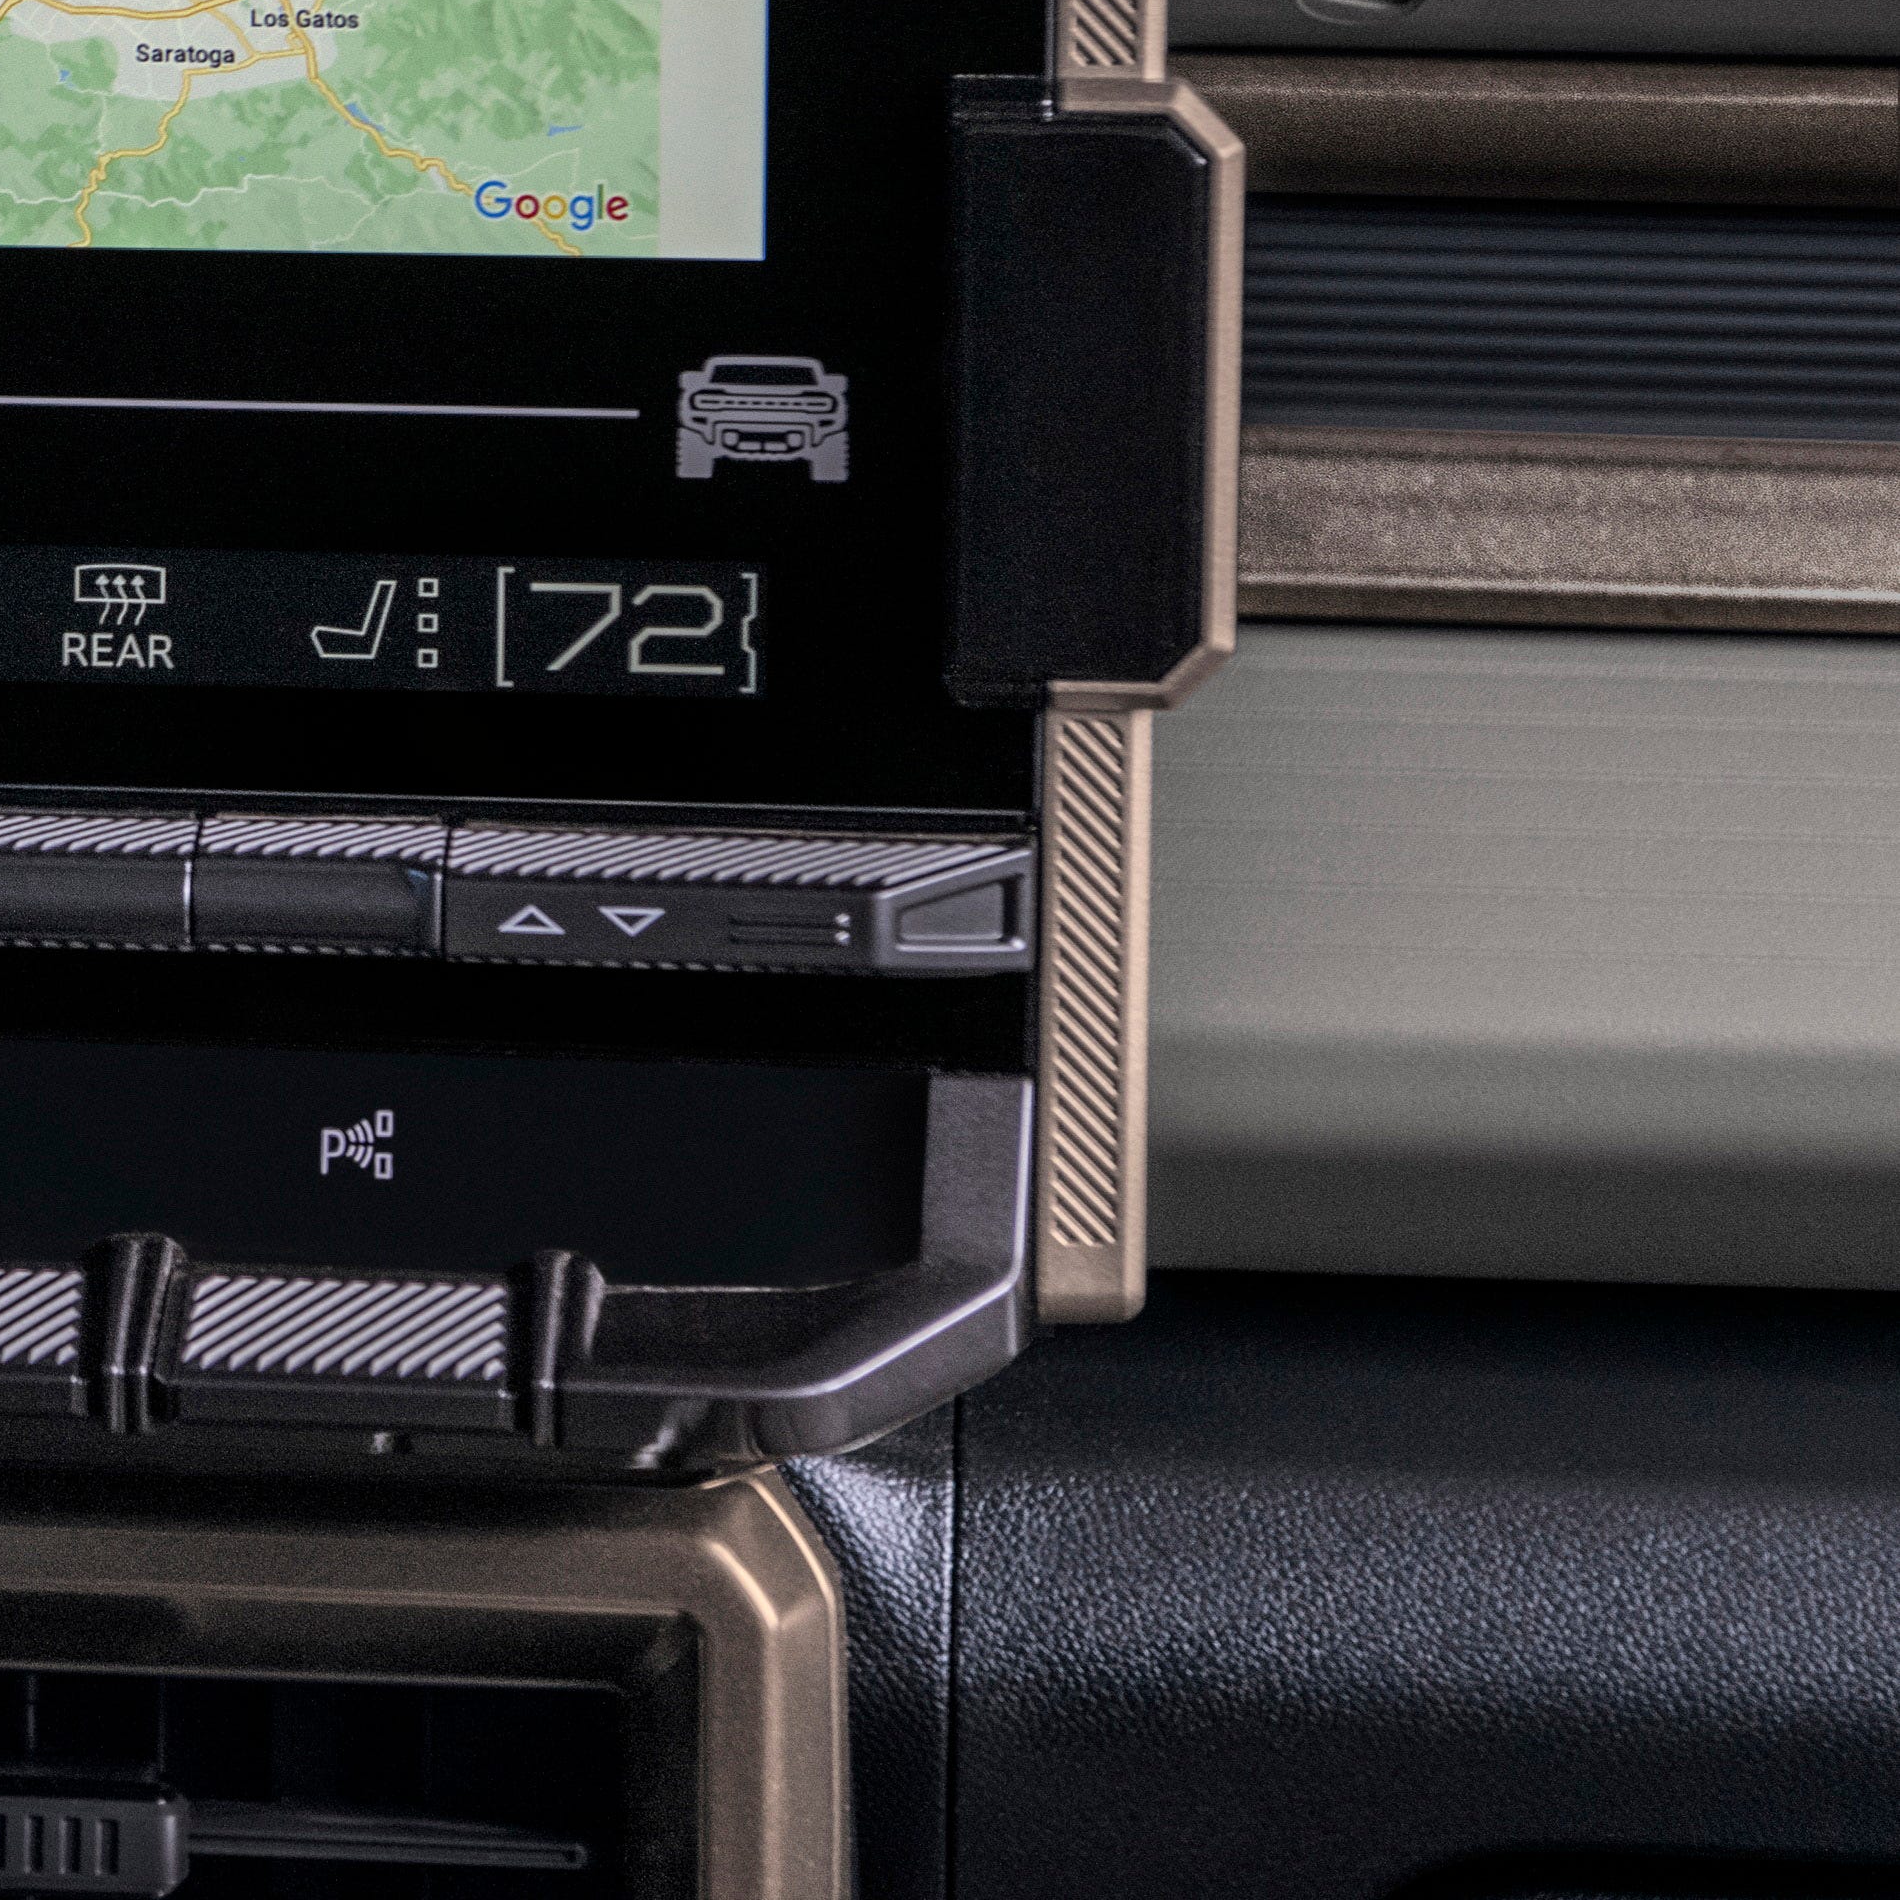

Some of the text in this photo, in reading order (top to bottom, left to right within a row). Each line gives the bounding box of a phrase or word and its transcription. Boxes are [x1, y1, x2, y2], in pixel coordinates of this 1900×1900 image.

[250, 10, 360, 30] Los Gatos
[135, 44, 236, 68] Saratoga
[474, 180, 630, 232] Google
[528, 582, 726, 676] 72
[61, 634, 174, 670] REAR
